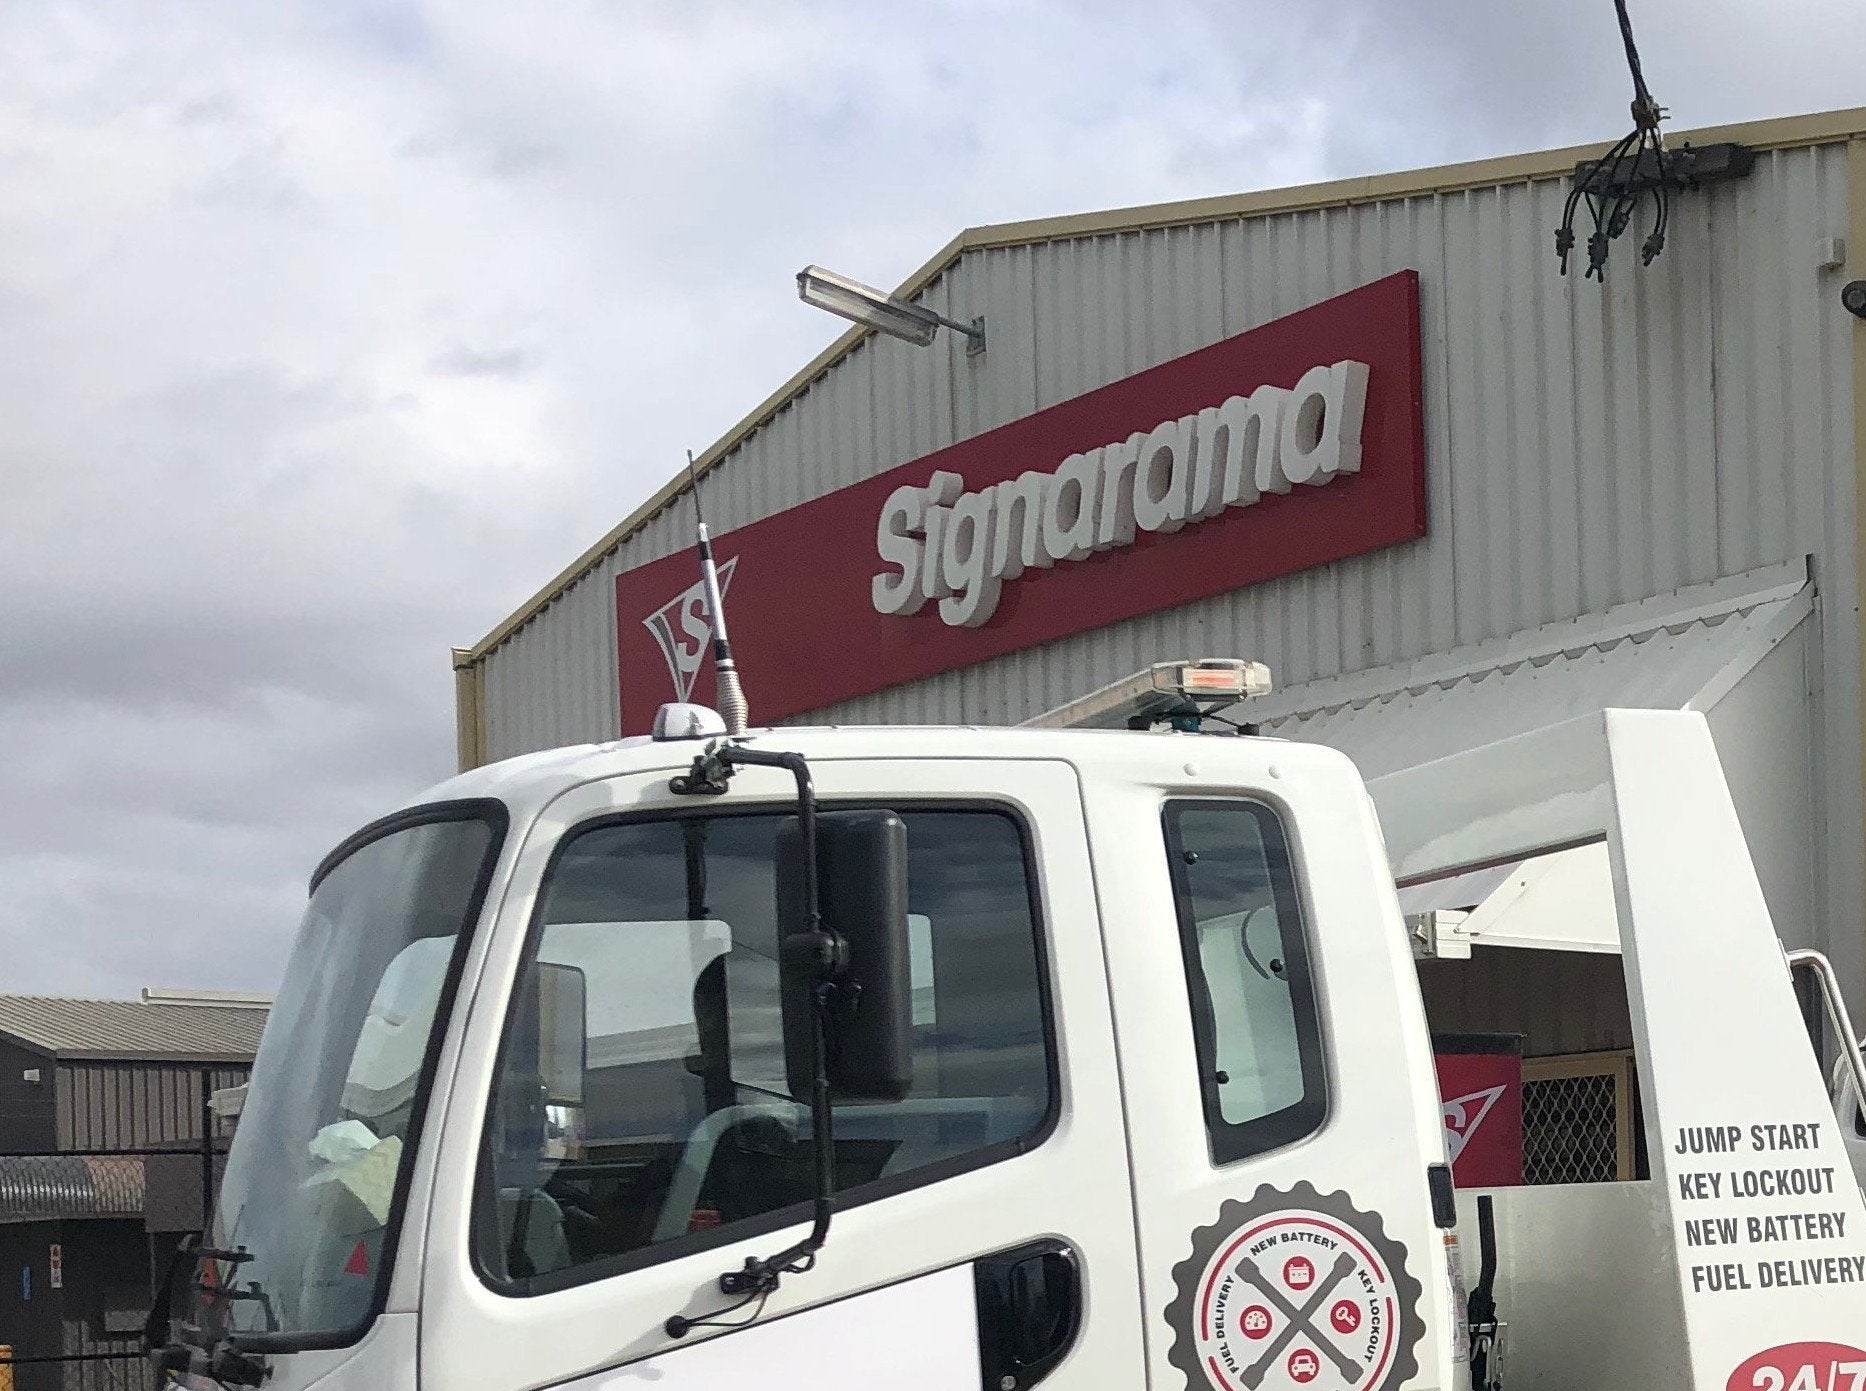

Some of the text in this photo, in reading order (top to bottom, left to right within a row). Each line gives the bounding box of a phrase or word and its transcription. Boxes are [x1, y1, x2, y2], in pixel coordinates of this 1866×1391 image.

[872, 358, 1371, 627] Signarama
[1675, 1122, 1821, 1155] JUMP START
[1678, 1167, 1835, 1200] KEY LOCKOUT
[1250, 1232, 1338, 1256] NEW BATTERY
[1685, 1212, 1847, 1247] NEW BATTERY
[1691, 1255, 1866, 1293] FUEL DELIVERY
[1215, 1275, 1239, 1374] FUEL DELIVERY
[1357, 1269, 1381, 1363] KEY LOCKOUT
